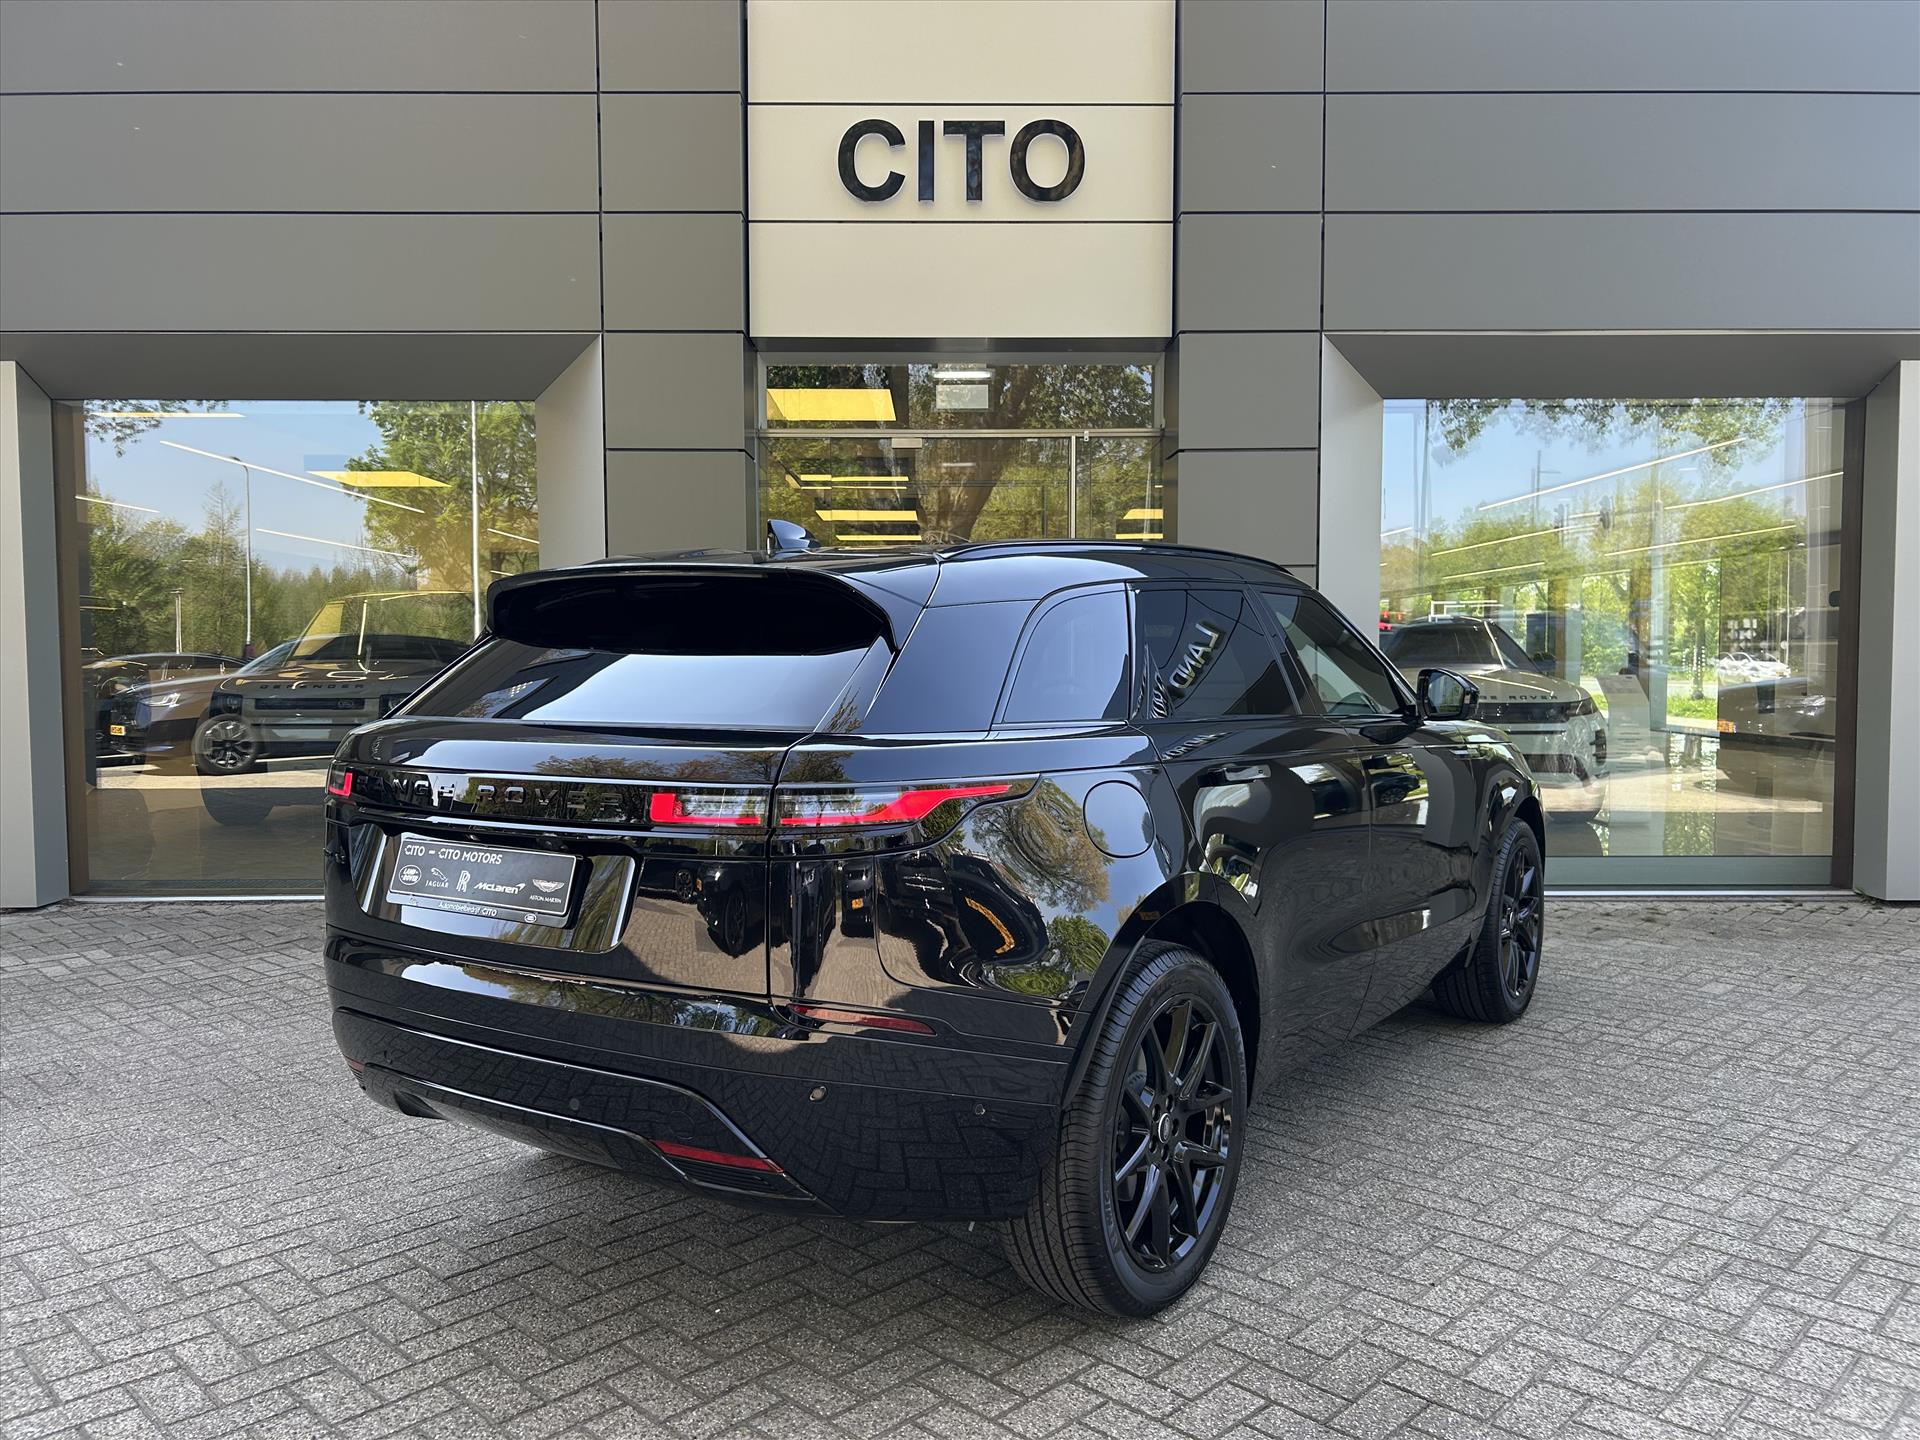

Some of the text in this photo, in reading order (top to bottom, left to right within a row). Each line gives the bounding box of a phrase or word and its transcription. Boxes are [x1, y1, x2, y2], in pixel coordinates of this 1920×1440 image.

[837, 118, 1086, 203] CITO
[476, 784, 624, 812] ROVER
[404, 845, 425, 857] CITO
[438, 848, 460, 860] CITO
[462, 851, 502, 864] MOTORS
[425, 880, 449, 888] JAGUAR
[474, 882, 520, 894] McLaren
[482, 908, 497, 916] CITO
